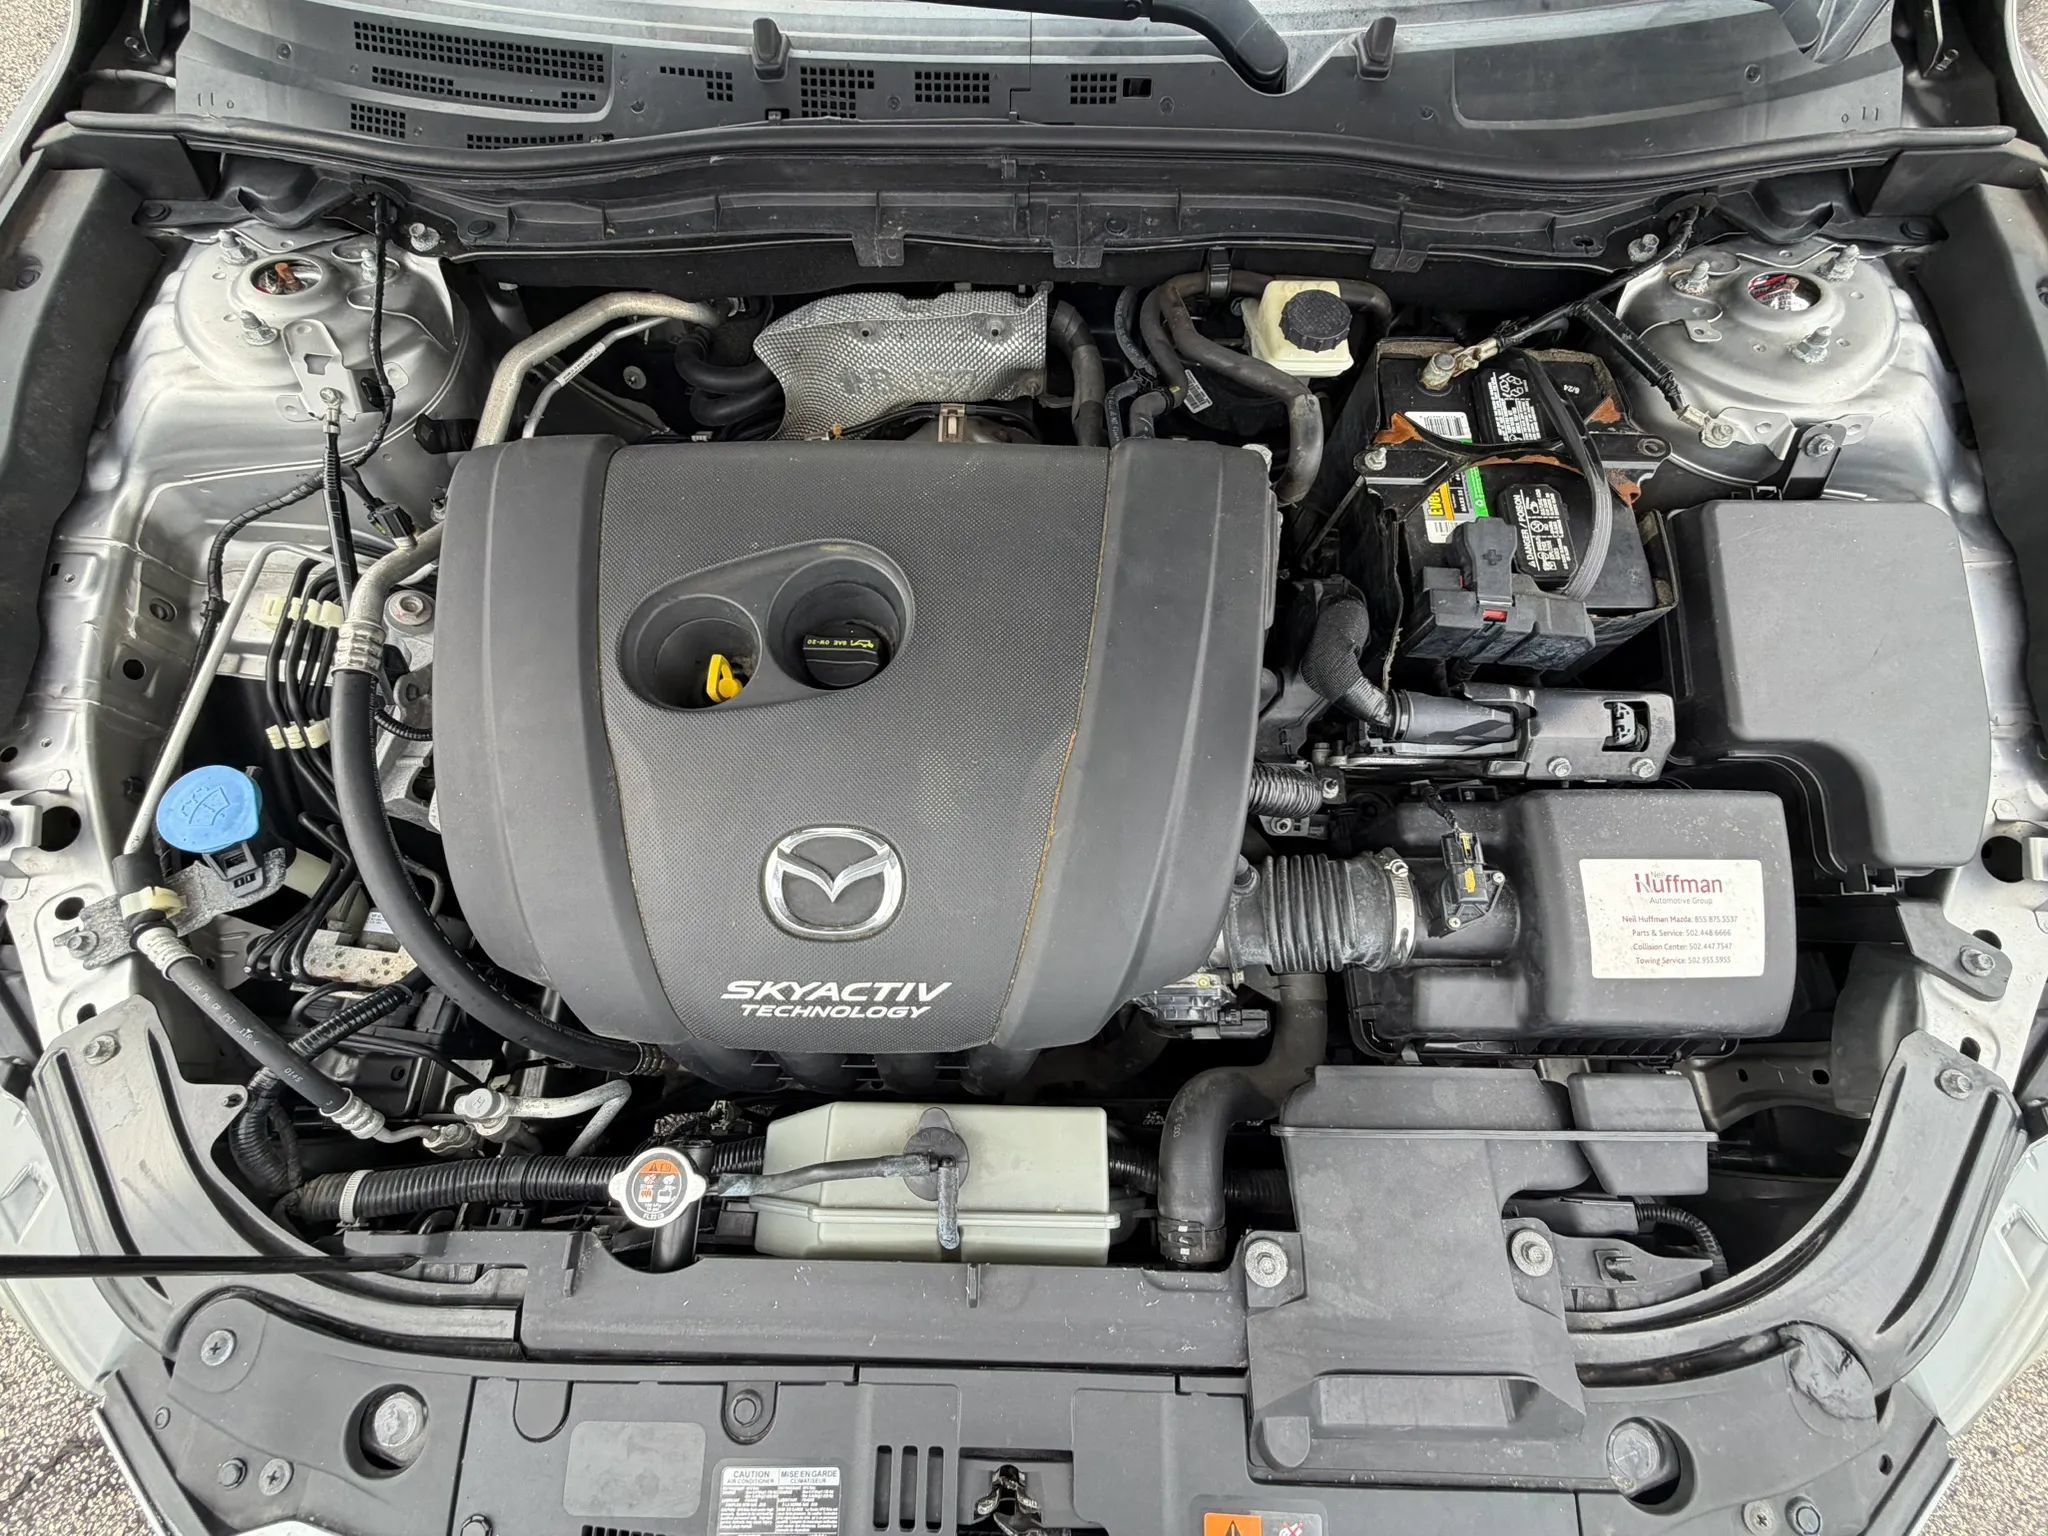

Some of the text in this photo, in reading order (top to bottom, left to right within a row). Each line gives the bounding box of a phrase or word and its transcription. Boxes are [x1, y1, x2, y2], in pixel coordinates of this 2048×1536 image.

[1513, 494, 1527, 522] POISON
[1521, 529, 1535, 561] DANGER
[1634, 873, 1723, 893] Huffman
[1649, 897, 1713, 906] Automotive Group
[1622, 915, 1637, 923] Neil
[1638, 915, 1669, 923] Huffman
[1669, 915, 1693, 923] Mazda:
[1632, 929, 1731, 937] Parts & Service: 502.448.6666
[1633, 943, 1662, 951] Collision
[1664, 943, 1687, 951] Center:
[1636, 957, 1661, 965] Towing
[1661, 956, 1686, 965] Service:
[720, 980, 952, 1001] SKYACTIV
[740, 1004, 932, 1018] TECHNOLOGY
[733, 1470, 838, 1478] CAUTION MISE EN GARDE
